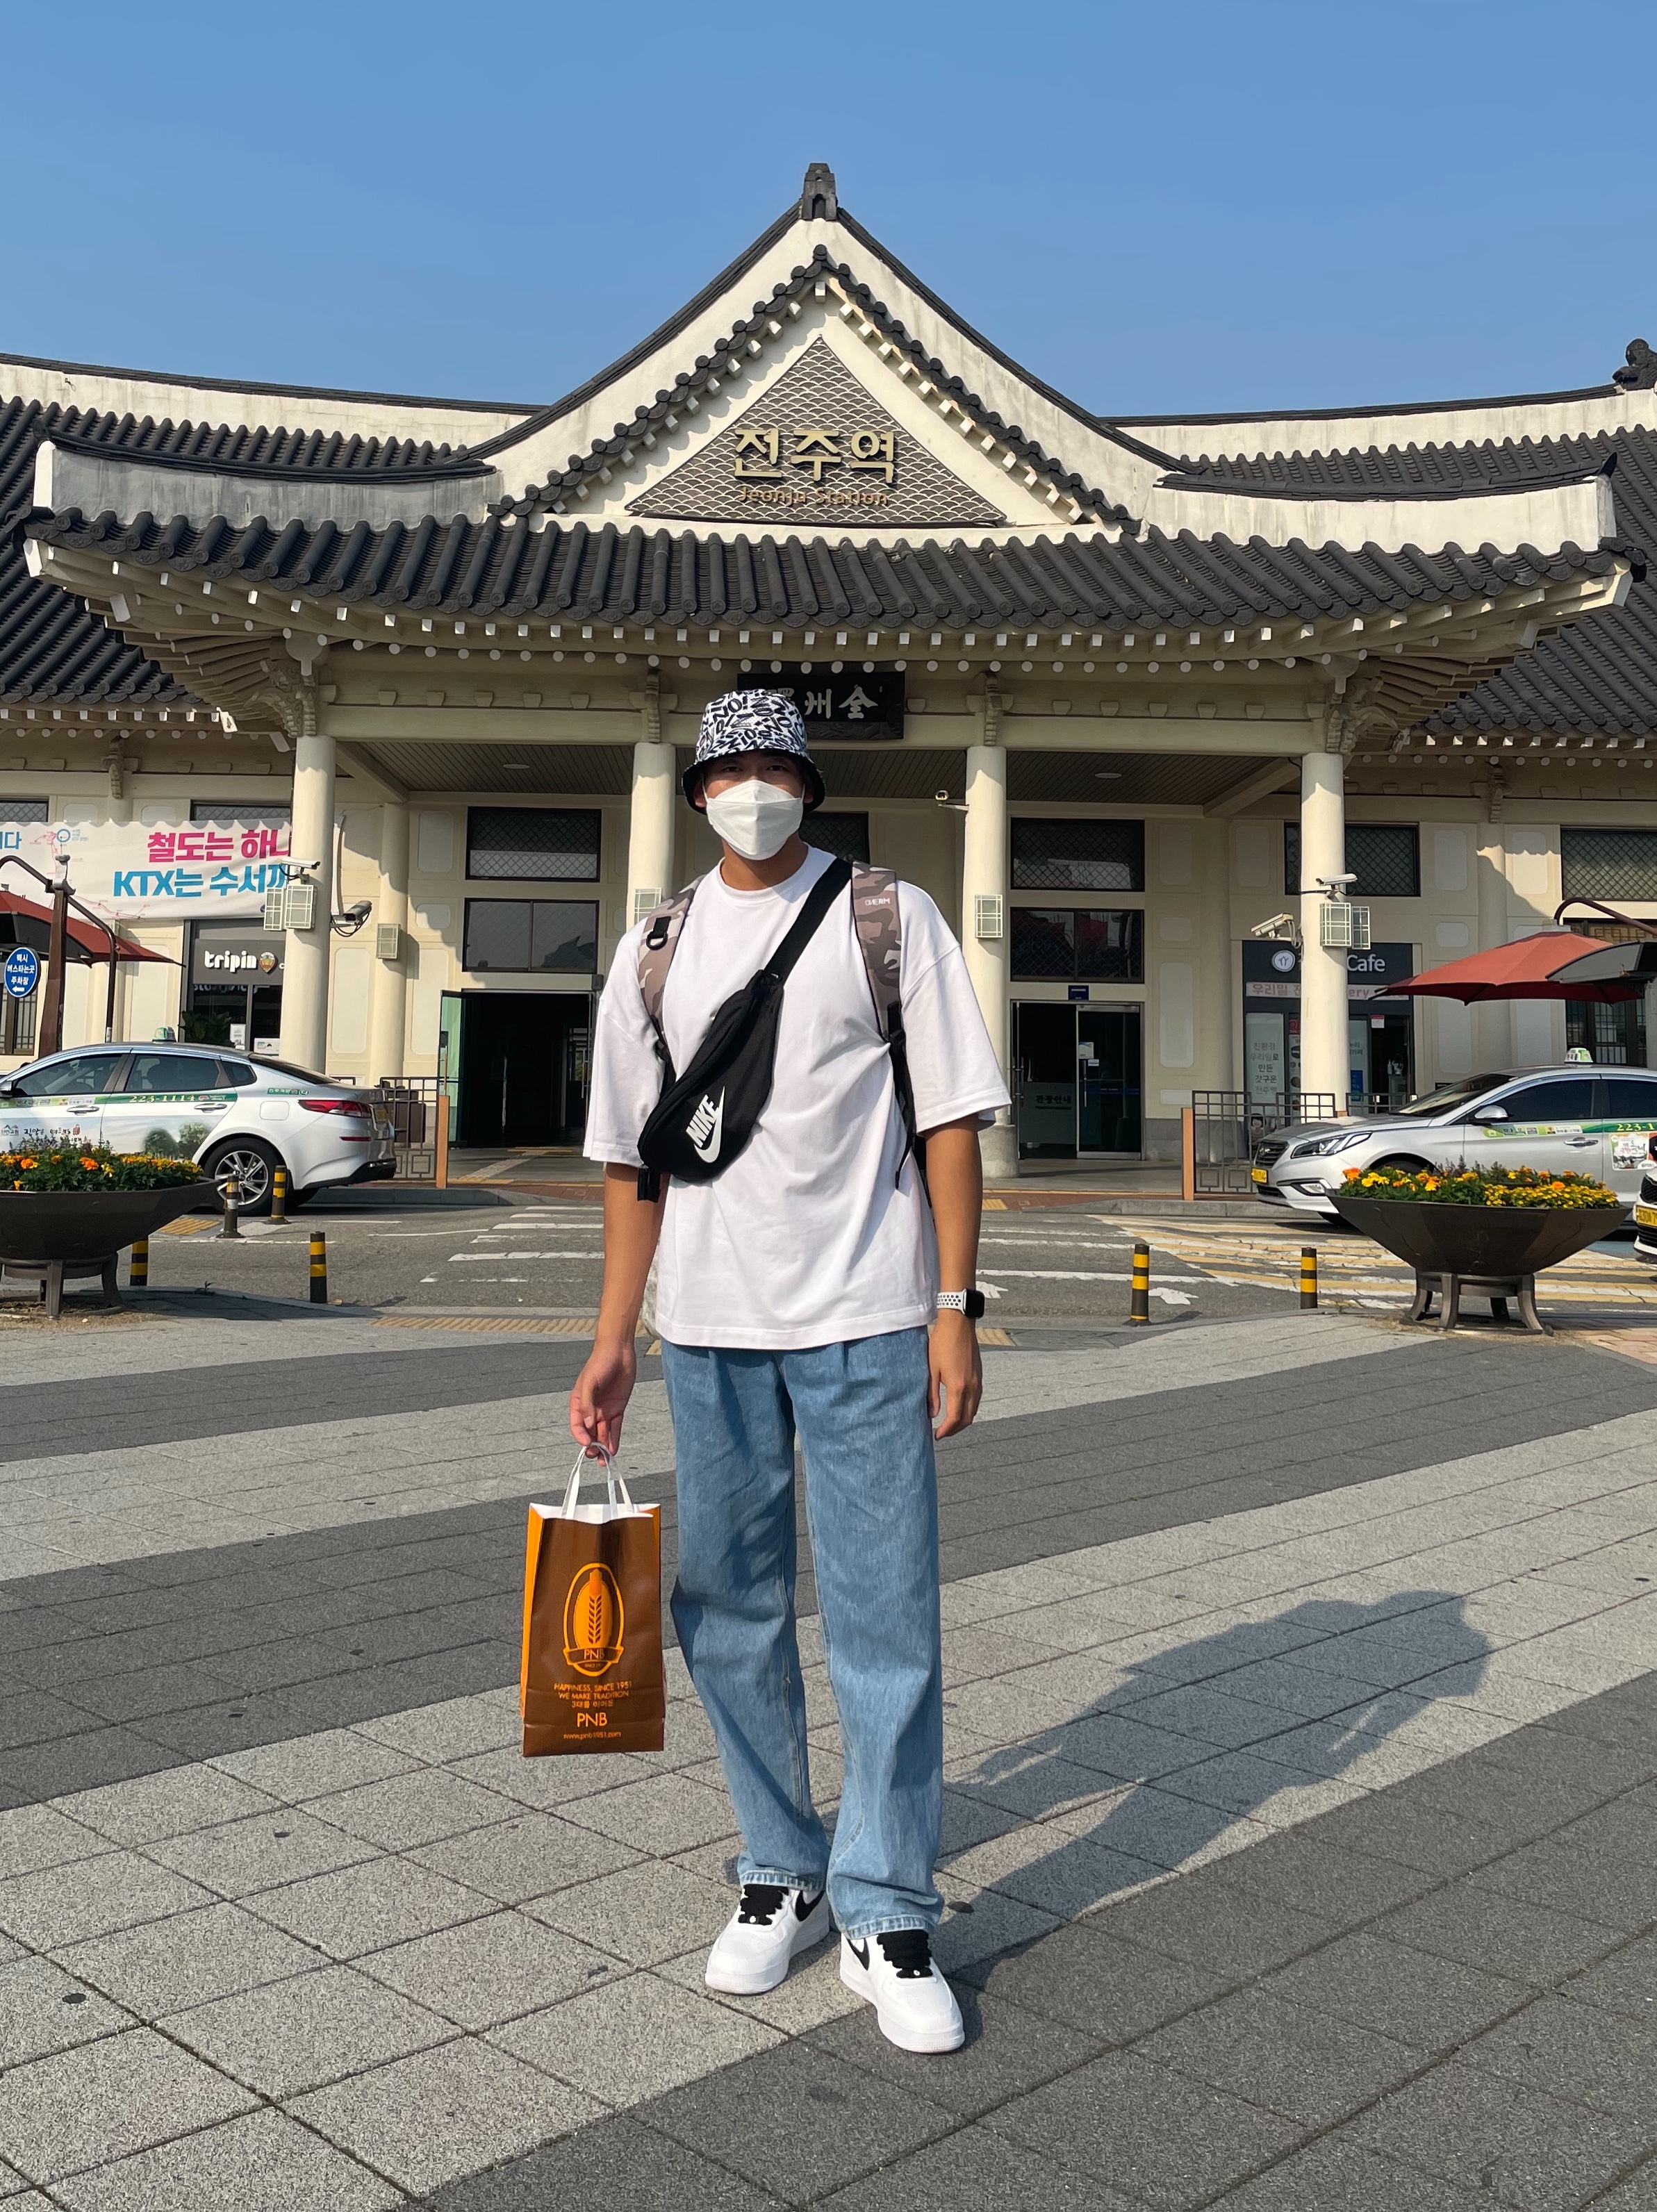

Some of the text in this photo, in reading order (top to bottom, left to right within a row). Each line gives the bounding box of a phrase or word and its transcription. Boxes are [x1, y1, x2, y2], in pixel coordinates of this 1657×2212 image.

[734, 428, 894, 484] 전주역
[738, 486, 888, 506] Jeonju Station
[147, 832, 234, 863] 철도는
[114, 868, 204, 897] KTX는
[204, 950, 257, 973] tripin
[1346, 954, 1385, 972] Cafe
[10, 976, 29, 985] 주차장
[1252, 983, 1288, 996] 우리밀
[1348, 989, 1369, 1000] ery
[1253, 1042, 1276, 1051] 친환경
[1258, 1064, 1273, 1073] 만든
[129, 1095, 195, 1103] 223-1114
[686, 1094, 718, 1148] NIKE
[1616, 1123, 1657, 1132] 223-1
[584, 1649, 604, 1660] PNB
[594, 1683, 614, 1692] SINCE
[558, 1690, 629, 1700] WE MAKE TRADITION
[577, 1712, 608, 1728] PNB
